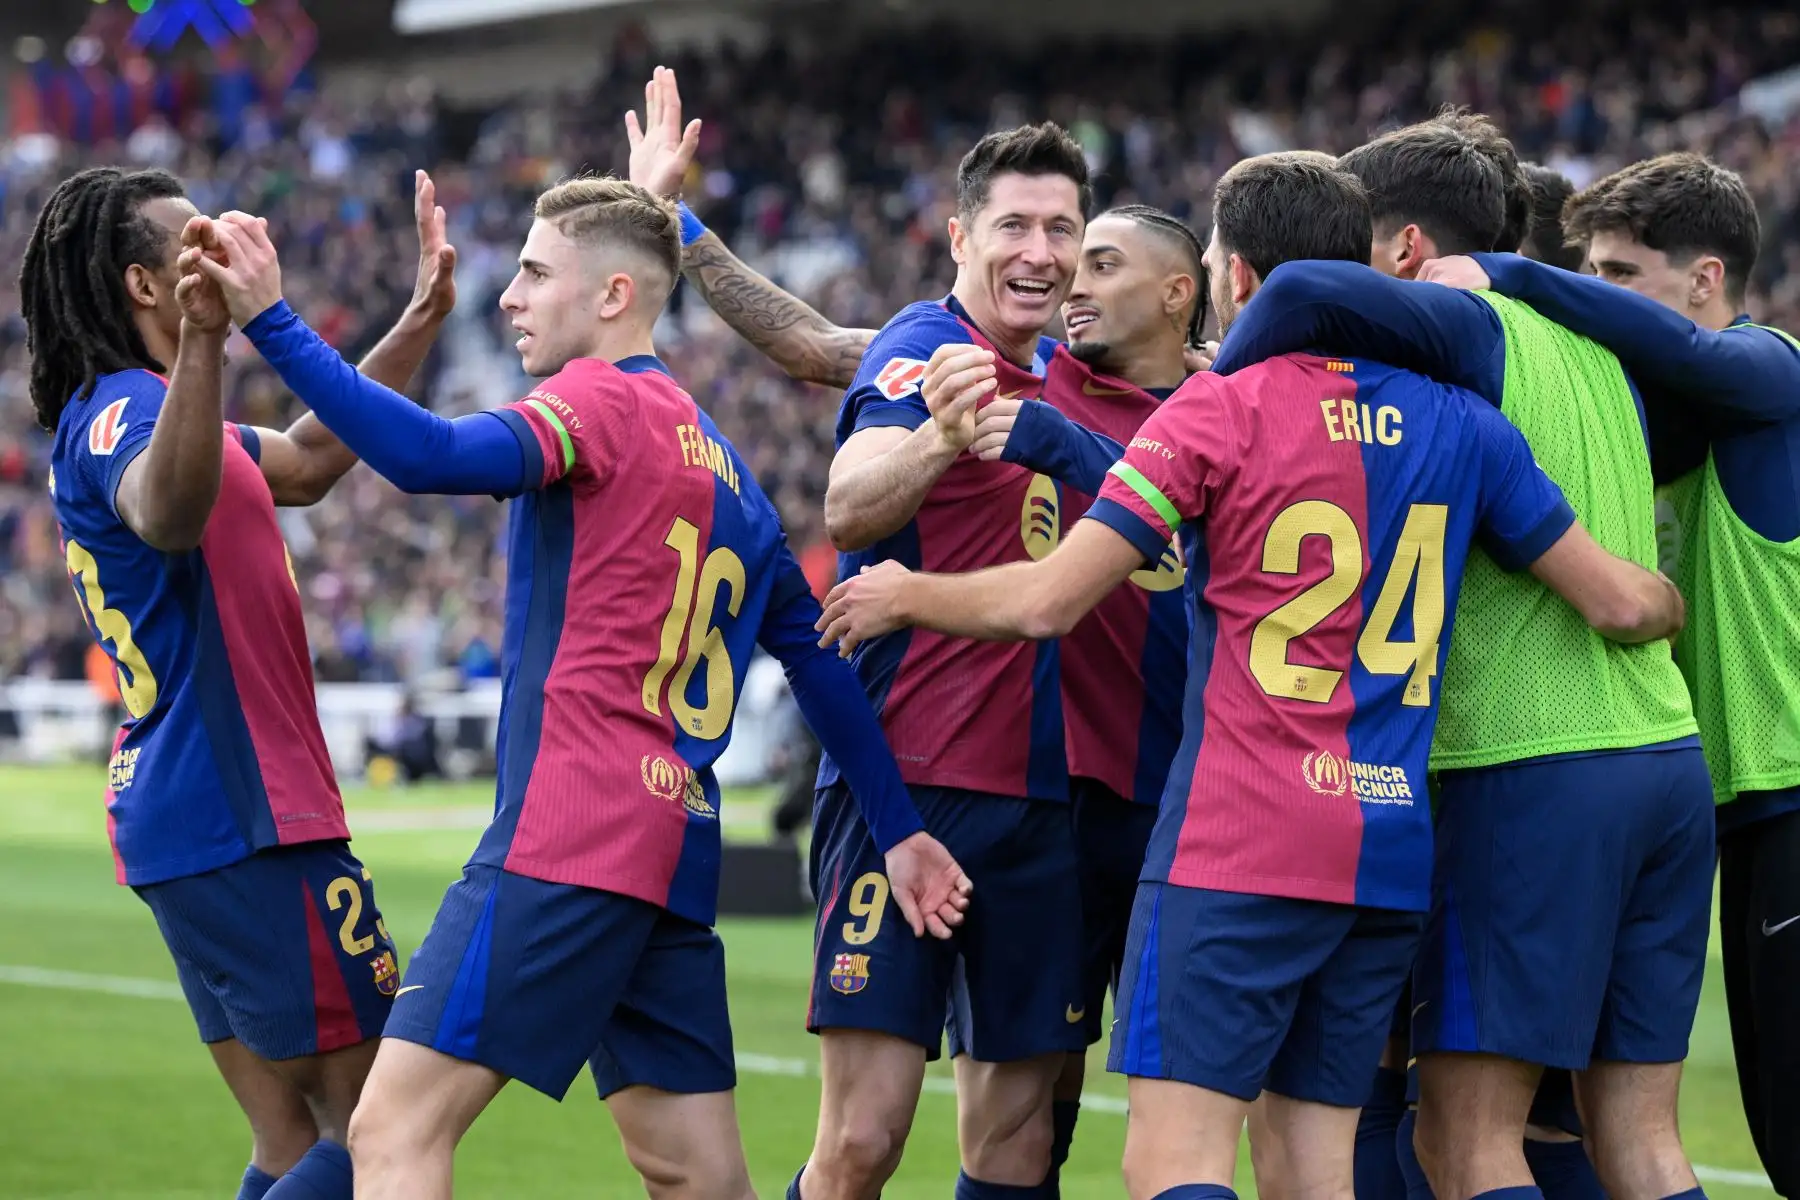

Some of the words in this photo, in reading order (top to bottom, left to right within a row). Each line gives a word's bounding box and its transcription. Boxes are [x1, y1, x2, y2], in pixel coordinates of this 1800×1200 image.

[1319, 398, 1403, 446] ERIC
[66, 537, 158, 720] 3
[641, 515, 747, 741] 16
[1248, 499, 1449, 707] 24
[1346, 759, 1408, 783] UNHCR
[1350, 776, 1413, 798] ACNUR
[842, 871, 889, 945] 9
